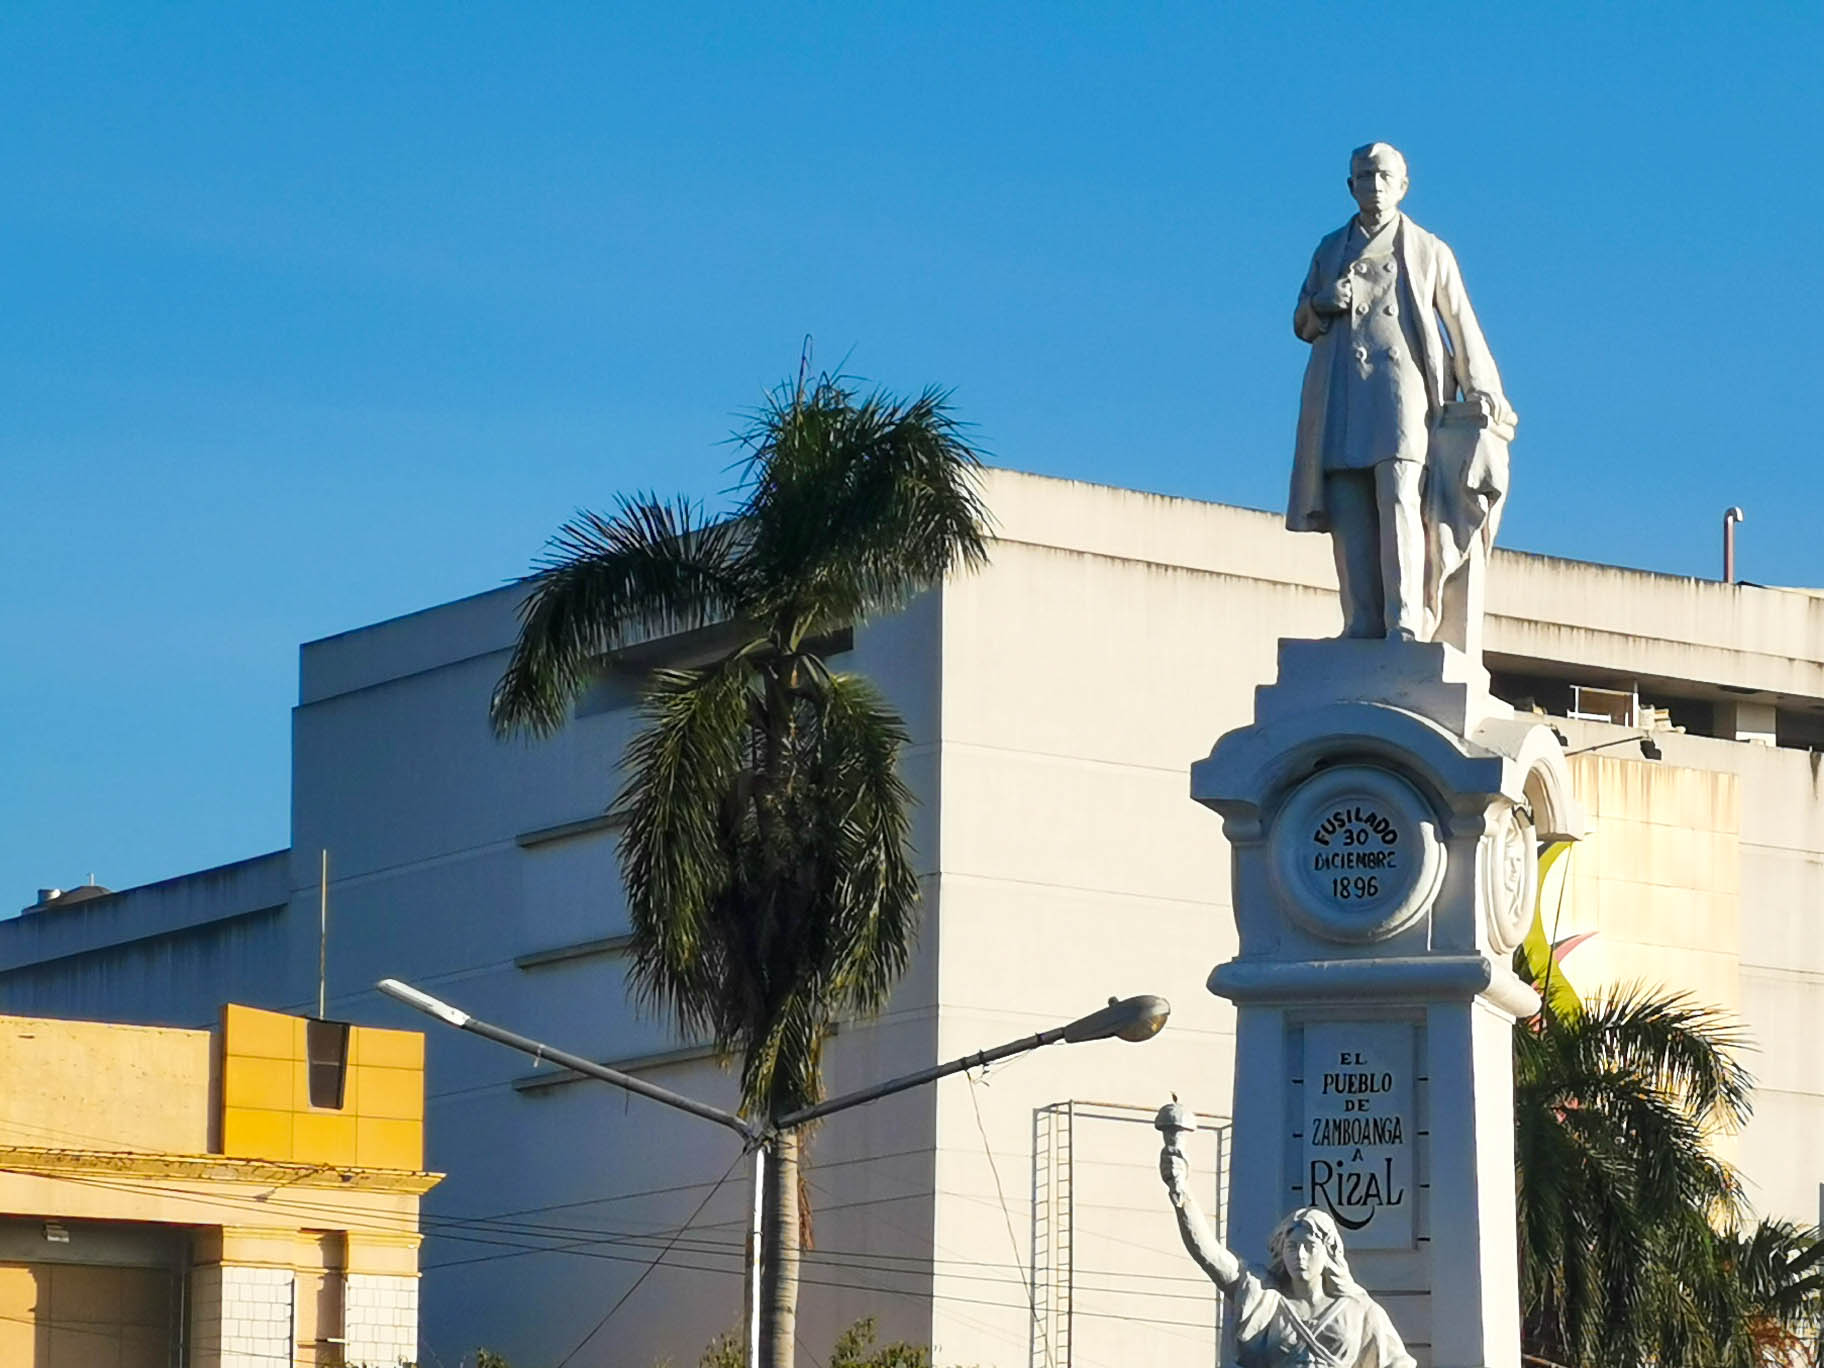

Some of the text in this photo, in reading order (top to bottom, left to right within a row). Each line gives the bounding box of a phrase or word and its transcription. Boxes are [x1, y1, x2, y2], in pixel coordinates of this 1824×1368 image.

[1313, 806, 1398, 847] FUSILADO
[1343, 828, 1369, 846] 30
[1313, 850, 1397, 871] DICIEMBRE
[1333, 876, 1379, 899] 1896
[1340, 1052, 1368, 1066] EL
[1322, 1072, 1393, 1095] PUEBLO
[1344, 1098, 1370, 1112] DE
[1311, 1115, 1404, 1146] ZAMBOANGA
[1351, 1148, 1364, 1162] A
